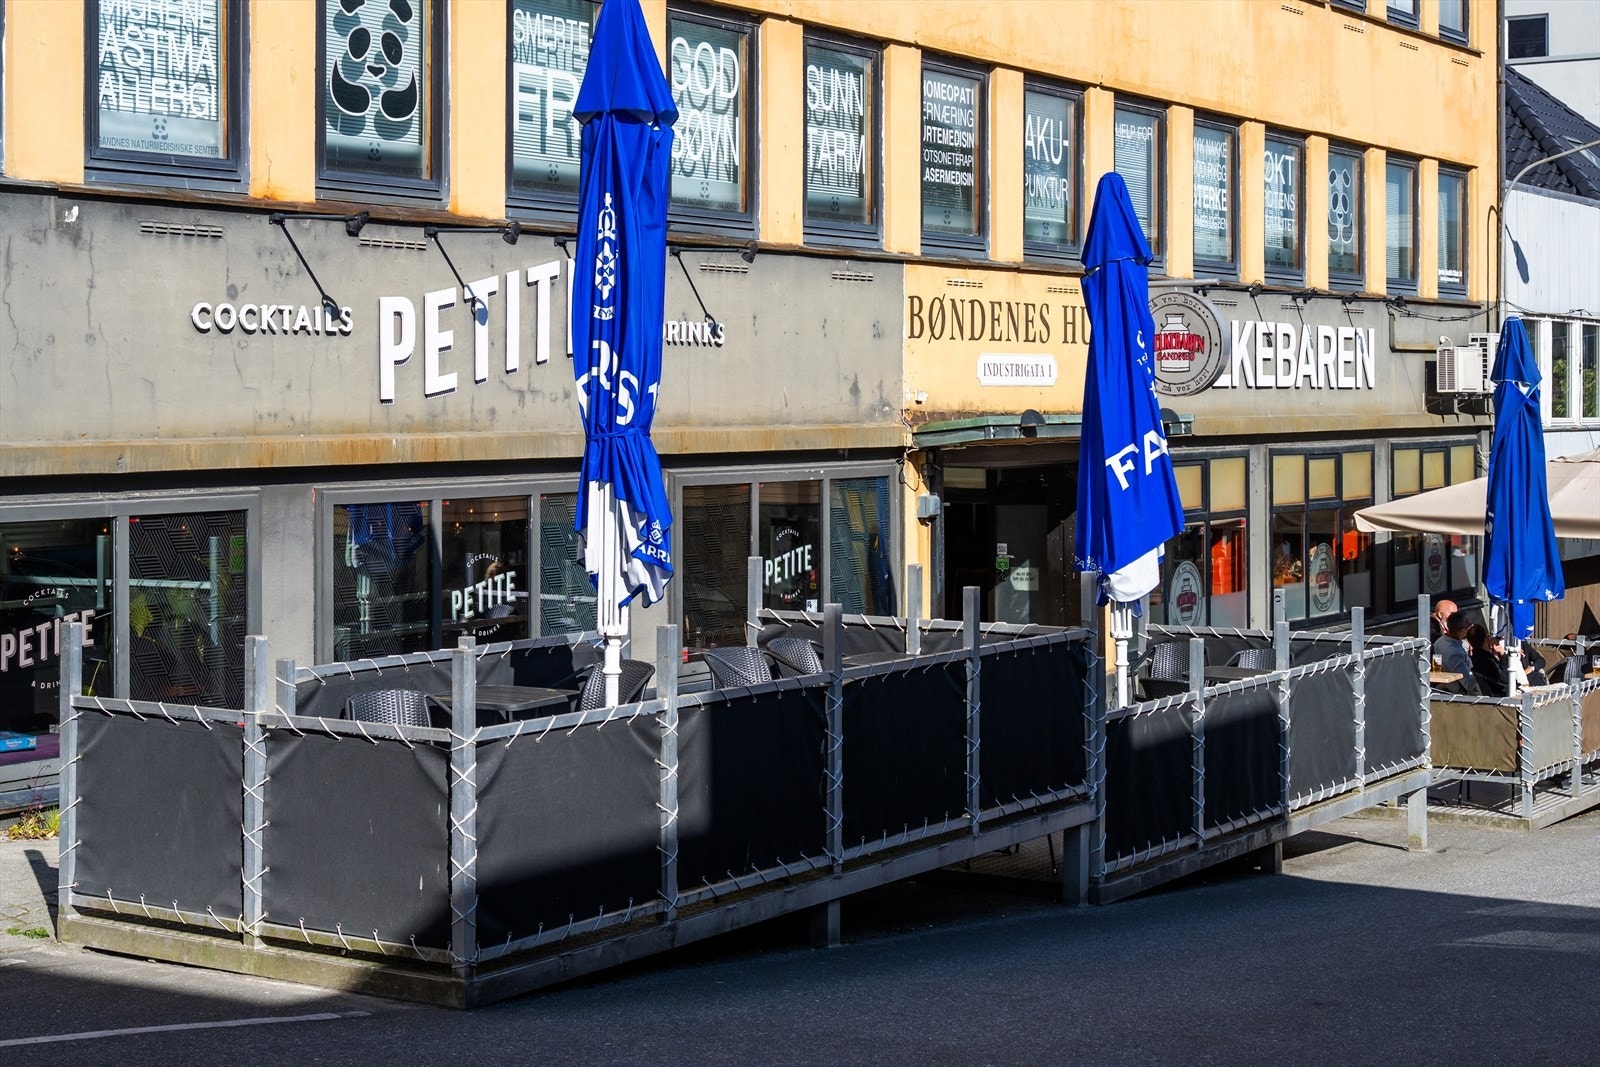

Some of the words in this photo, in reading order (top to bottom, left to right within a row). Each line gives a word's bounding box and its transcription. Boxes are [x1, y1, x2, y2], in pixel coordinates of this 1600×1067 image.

[513, 8, 593, 51] SMERTE-
[99, 23, 217, 76] ASTMA
[672, 36, 739, 99] GOD
[99, 70, 216, 120] ALLERGI
[807, 64, 864, 117] SUNN
[132, 139, 193, 153] NATURMEDISINSKE
[194, 145, 219, 156] SENTER
[1025, 114, 1069, 165] AKU-
[1137, 126, 1153, 141] FOR
[807, 127, 865, 175] TARM
[923, 148, 974, 168] OTSONETERAPI
[1264, 151, 1295, 187] ØKT
[1264, 189, 1296, 211] OTENS
[191, 302, 354, 334] COCKTAILS
[663, 320, 726, 345] RINKS
[908, 293, 1051, 344] BØNDENES
[983, 362, 1045, 378] INDUSTRIGATA
[1156, 351, 1196, 361] SANDNES
[1105, 420, 1169, 491] FA
[775, 528, 800, 541] COCKTAILS
[466, 553, 499, 568] COCKTAILS
[765, 544, 812, 586] PETITE
[23, 587, 70, 606] COCKTAILS
[451, 570, 517, 622] PETITE
[478, 623, 500, 637] DRINKS
